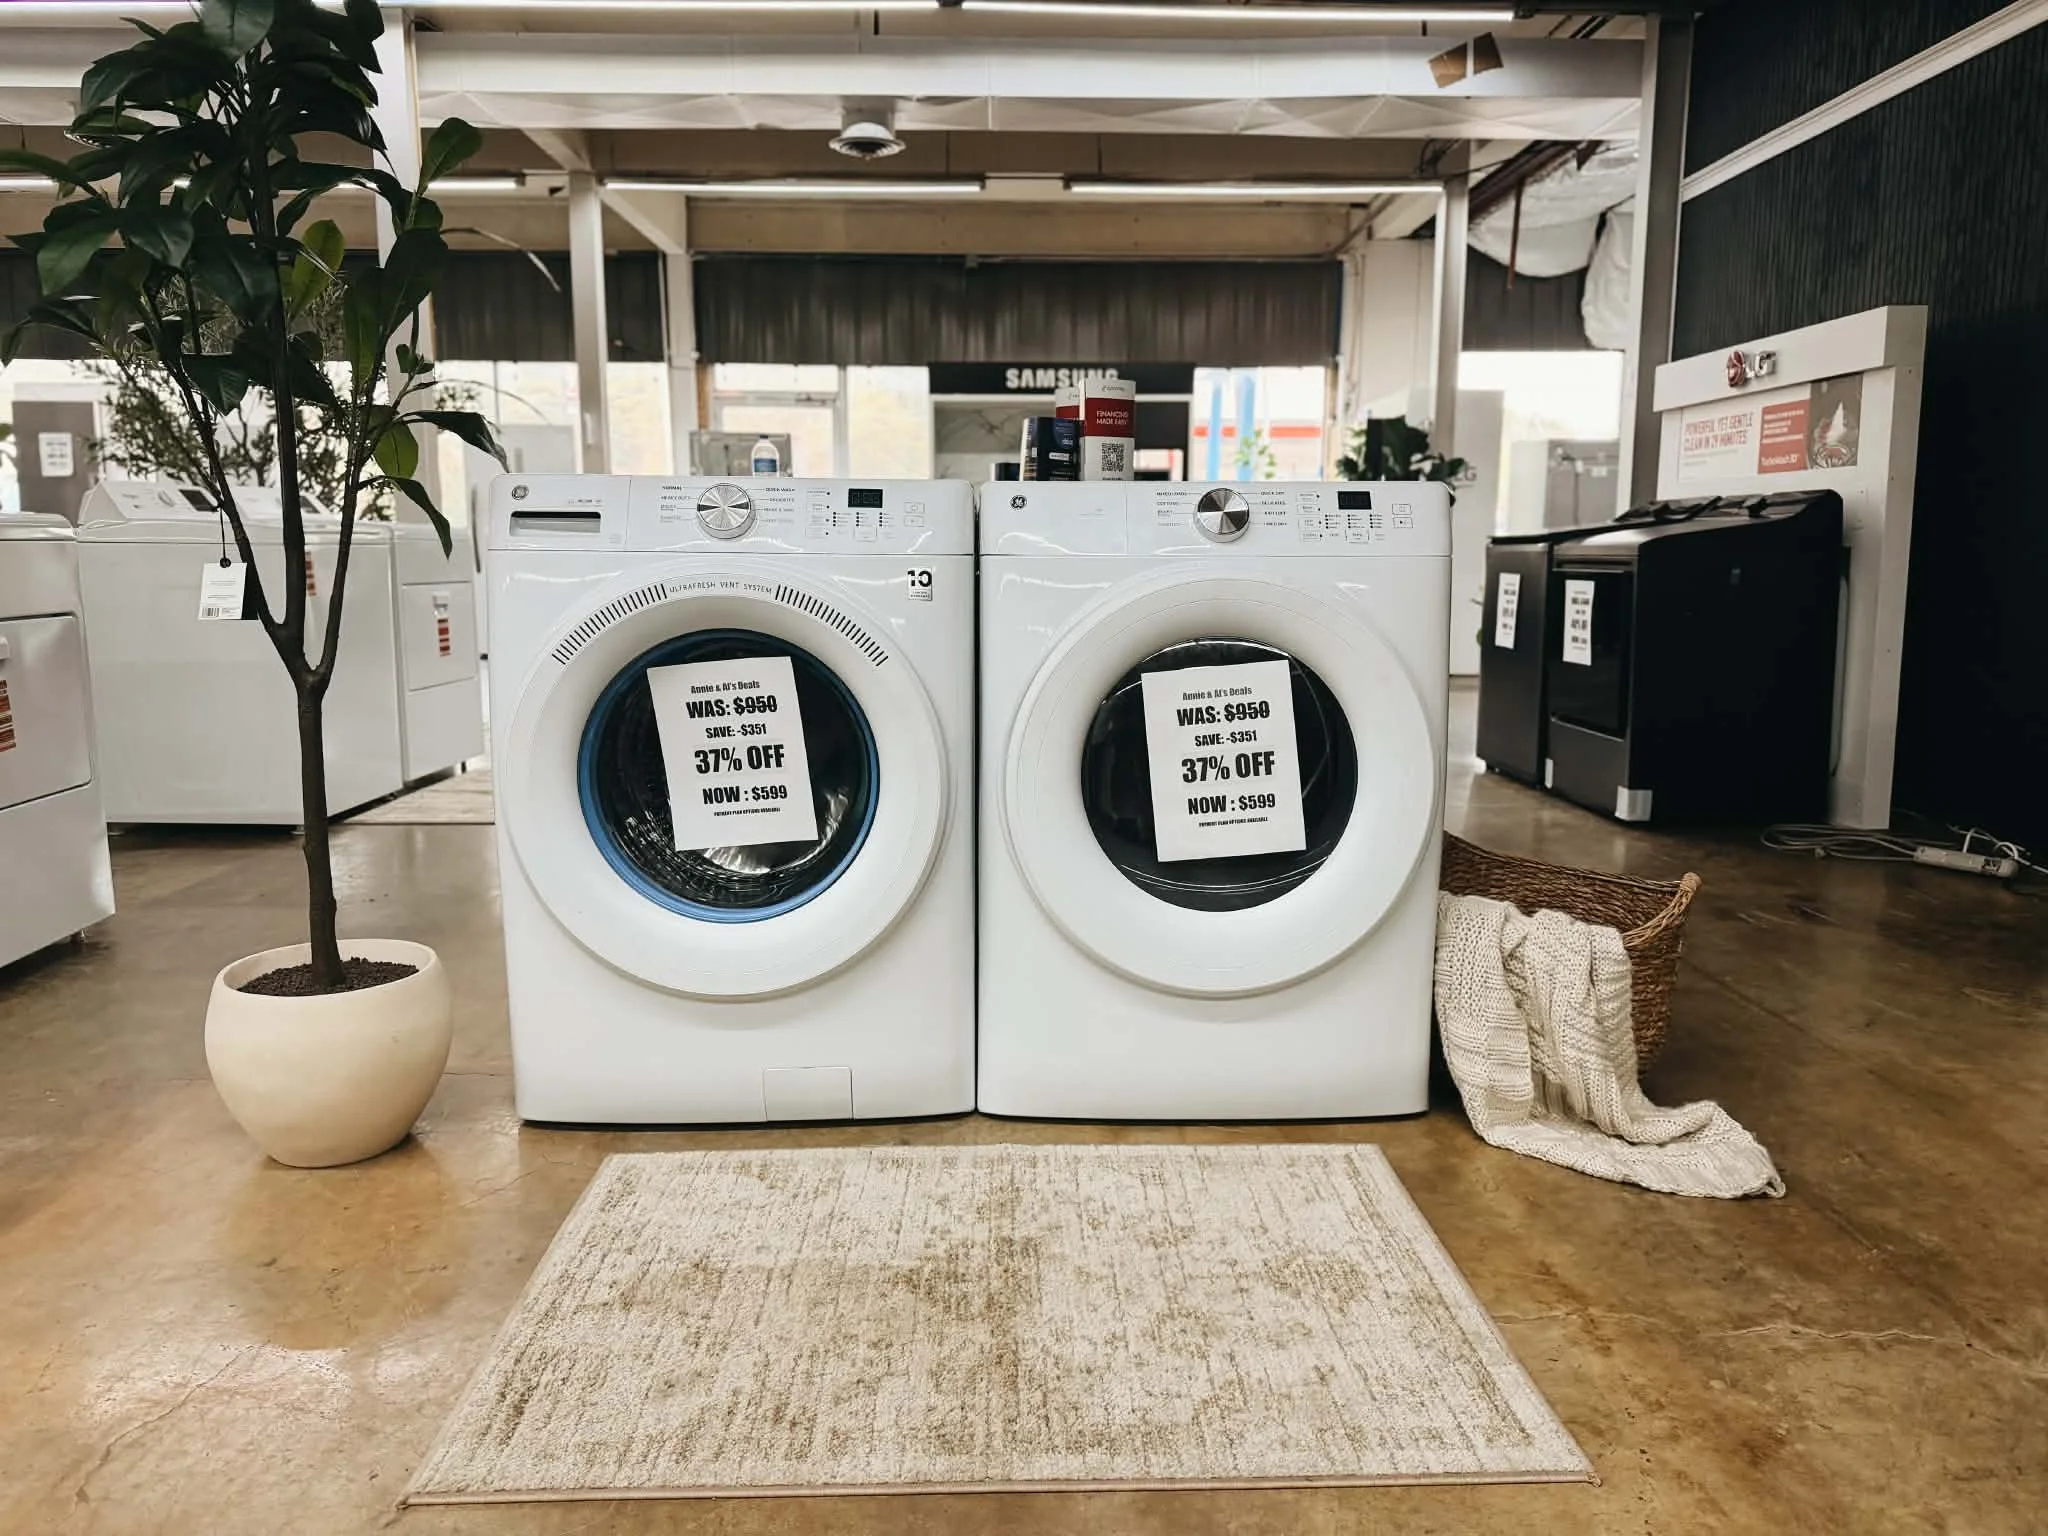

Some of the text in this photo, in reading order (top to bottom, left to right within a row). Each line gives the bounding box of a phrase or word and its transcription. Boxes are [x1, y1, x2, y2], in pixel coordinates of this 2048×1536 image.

[1097, 410, 1129, 418] FINANCING
[907, 570, 932, 587] 10
[720, 581, 740, 589] VENT
[744, 584, 772, 594] SYSTEM
[691, 685, 714, 694] Annie
[738, 680, 760, 690] Deals
[1182, 691, 1205, 701] Annie
[1207, 691, 1212, 699] &
[1229, 686, 1252, 696] Deals
[686, 695, 778, 719] WAS: $950
[1177, 701, 1270, 726] WAS: $950
[705, 723, 767, 739] SAVE: -$351
[1195, 730, 1257, 747] SAVE: -$351
[695, 744, 785, 774] 37% OFF
[1182, 751, 1275, 783] 37% OFF
[703, 786, 740, 804] NOW
[752, 785, 788, 802] $599
[1188, 795, 1227, 815] NOW
[1239, 793, 1275, 812] $599
